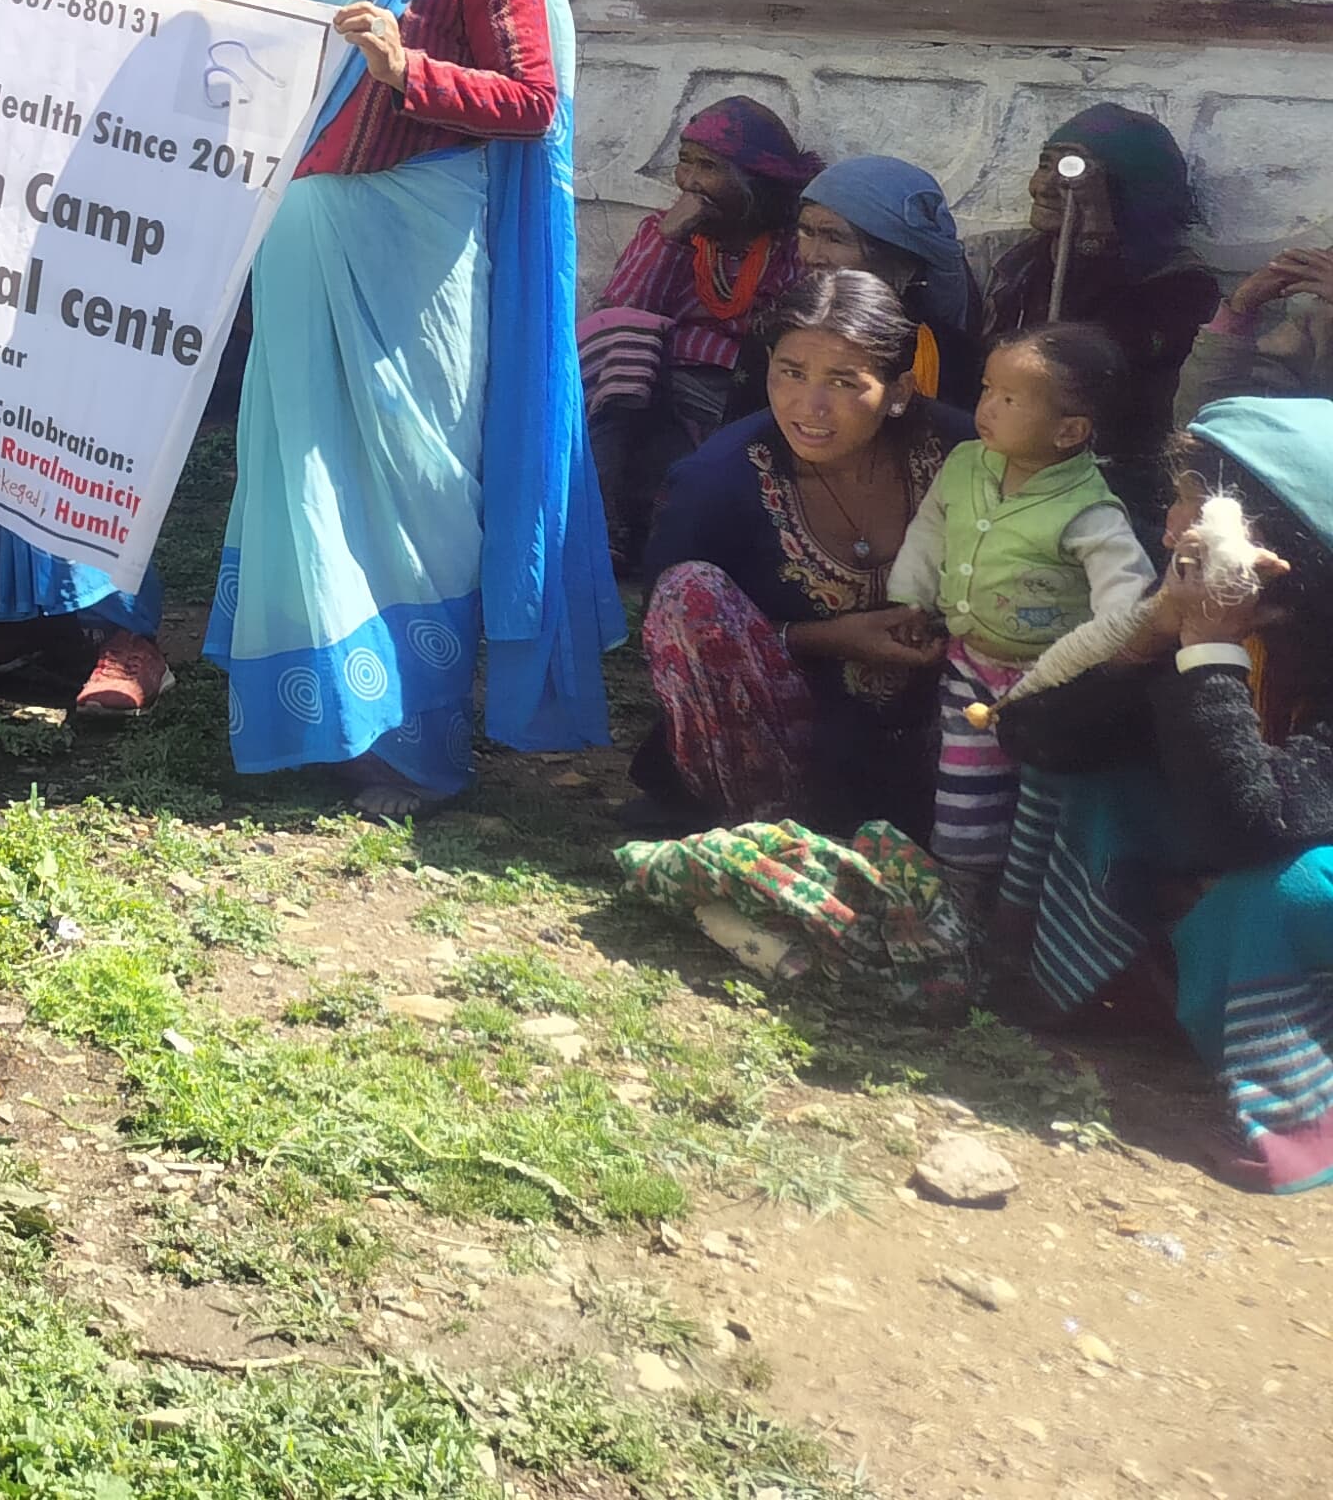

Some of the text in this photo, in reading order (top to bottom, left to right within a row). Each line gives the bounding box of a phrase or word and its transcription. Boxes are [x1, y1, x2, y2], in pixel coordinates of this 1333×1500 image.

[92, 111, 178, 165] Since
[189, 137, 281, 189] 2017
[25, 182, 166, 266] Camp
[60, 287, 203, 367] cente
